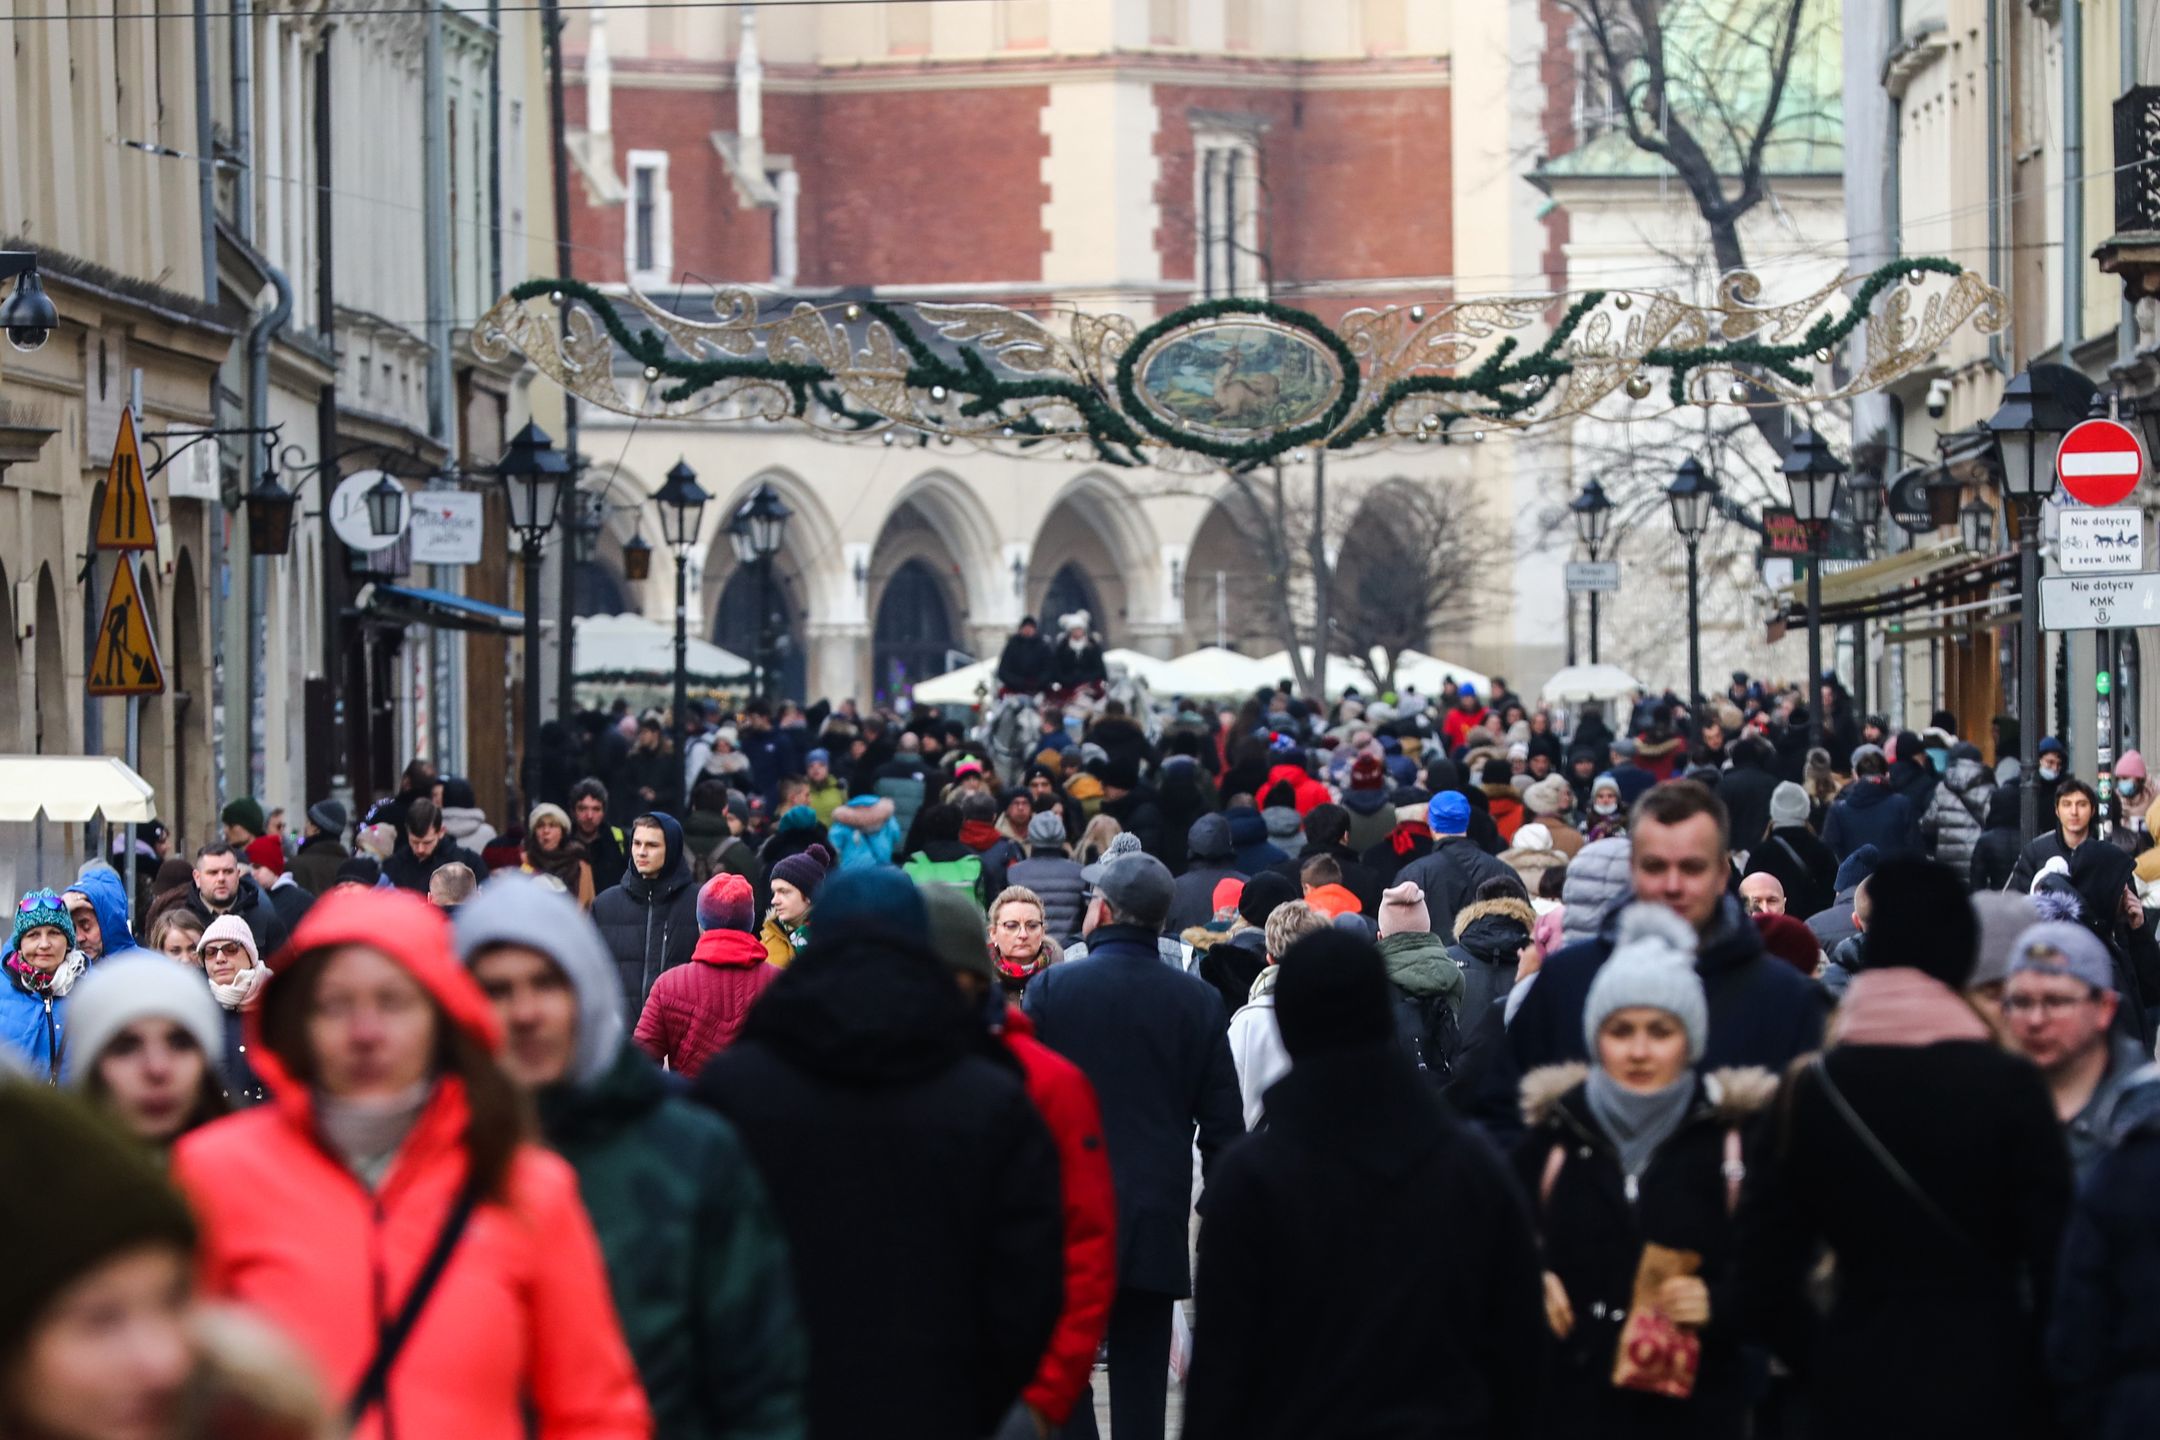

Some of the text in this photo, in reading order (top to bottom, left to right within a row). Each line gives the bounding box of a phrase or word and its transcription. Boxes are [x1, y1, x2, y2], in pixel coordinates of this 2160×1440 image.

[2071, 517, 2132, 527] Nie dotyczy
[2109, 554, 2132, 564] UMK
[2071, 581, 2134, 592] Nie dotyczy
[2089, 596, 2115, 606] KMK
